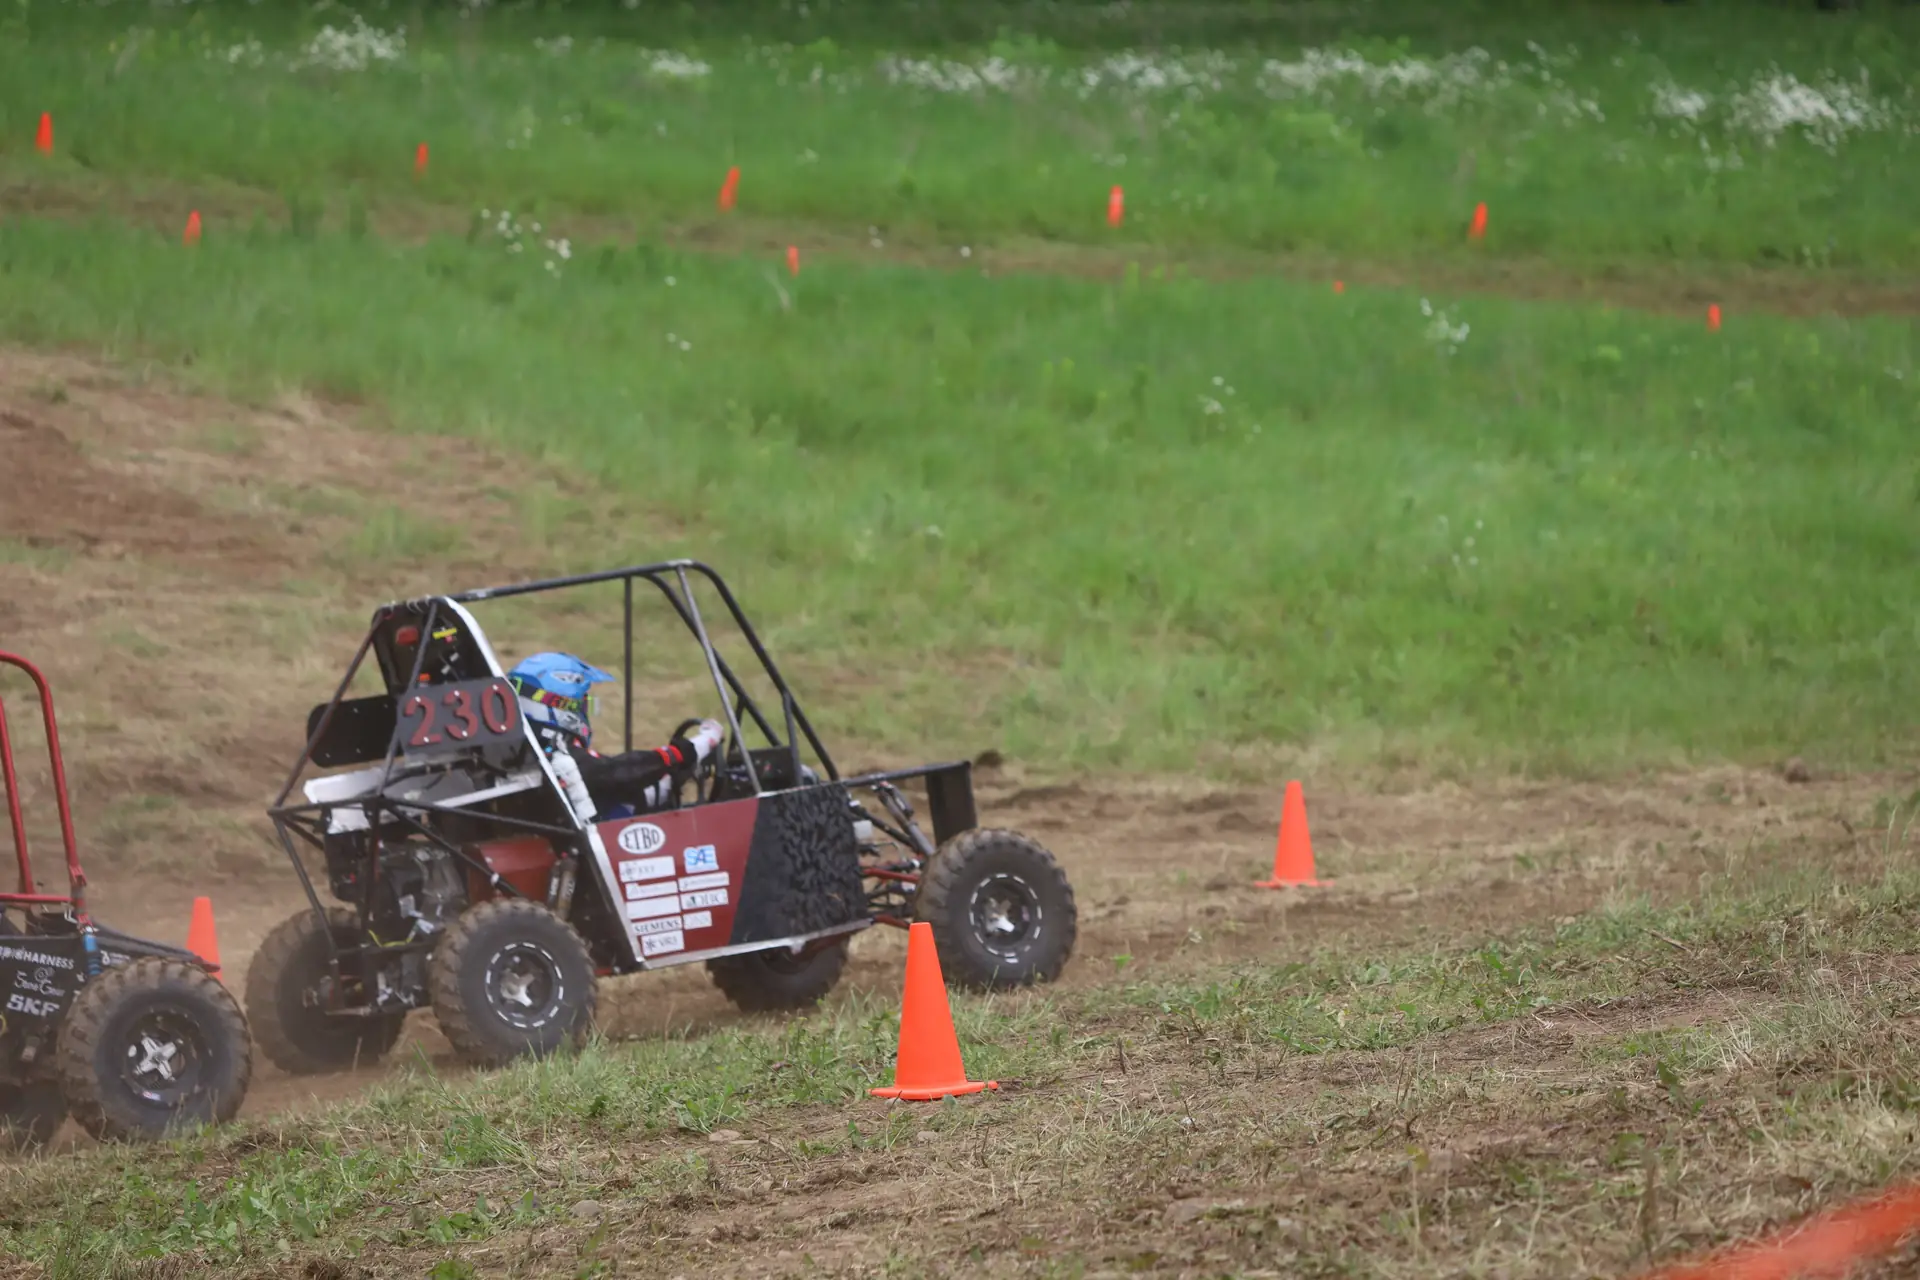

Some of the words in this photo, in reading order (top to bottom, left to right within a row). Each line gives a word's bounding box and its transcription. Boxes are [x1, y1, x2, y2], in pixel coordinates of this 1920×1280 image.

[404, 683, 517, 746] 230
[686, 845, 715, 867] SAE
[634, 919, 680, 933] SIEMENS
[6, 993, 60, 1017] SKF
